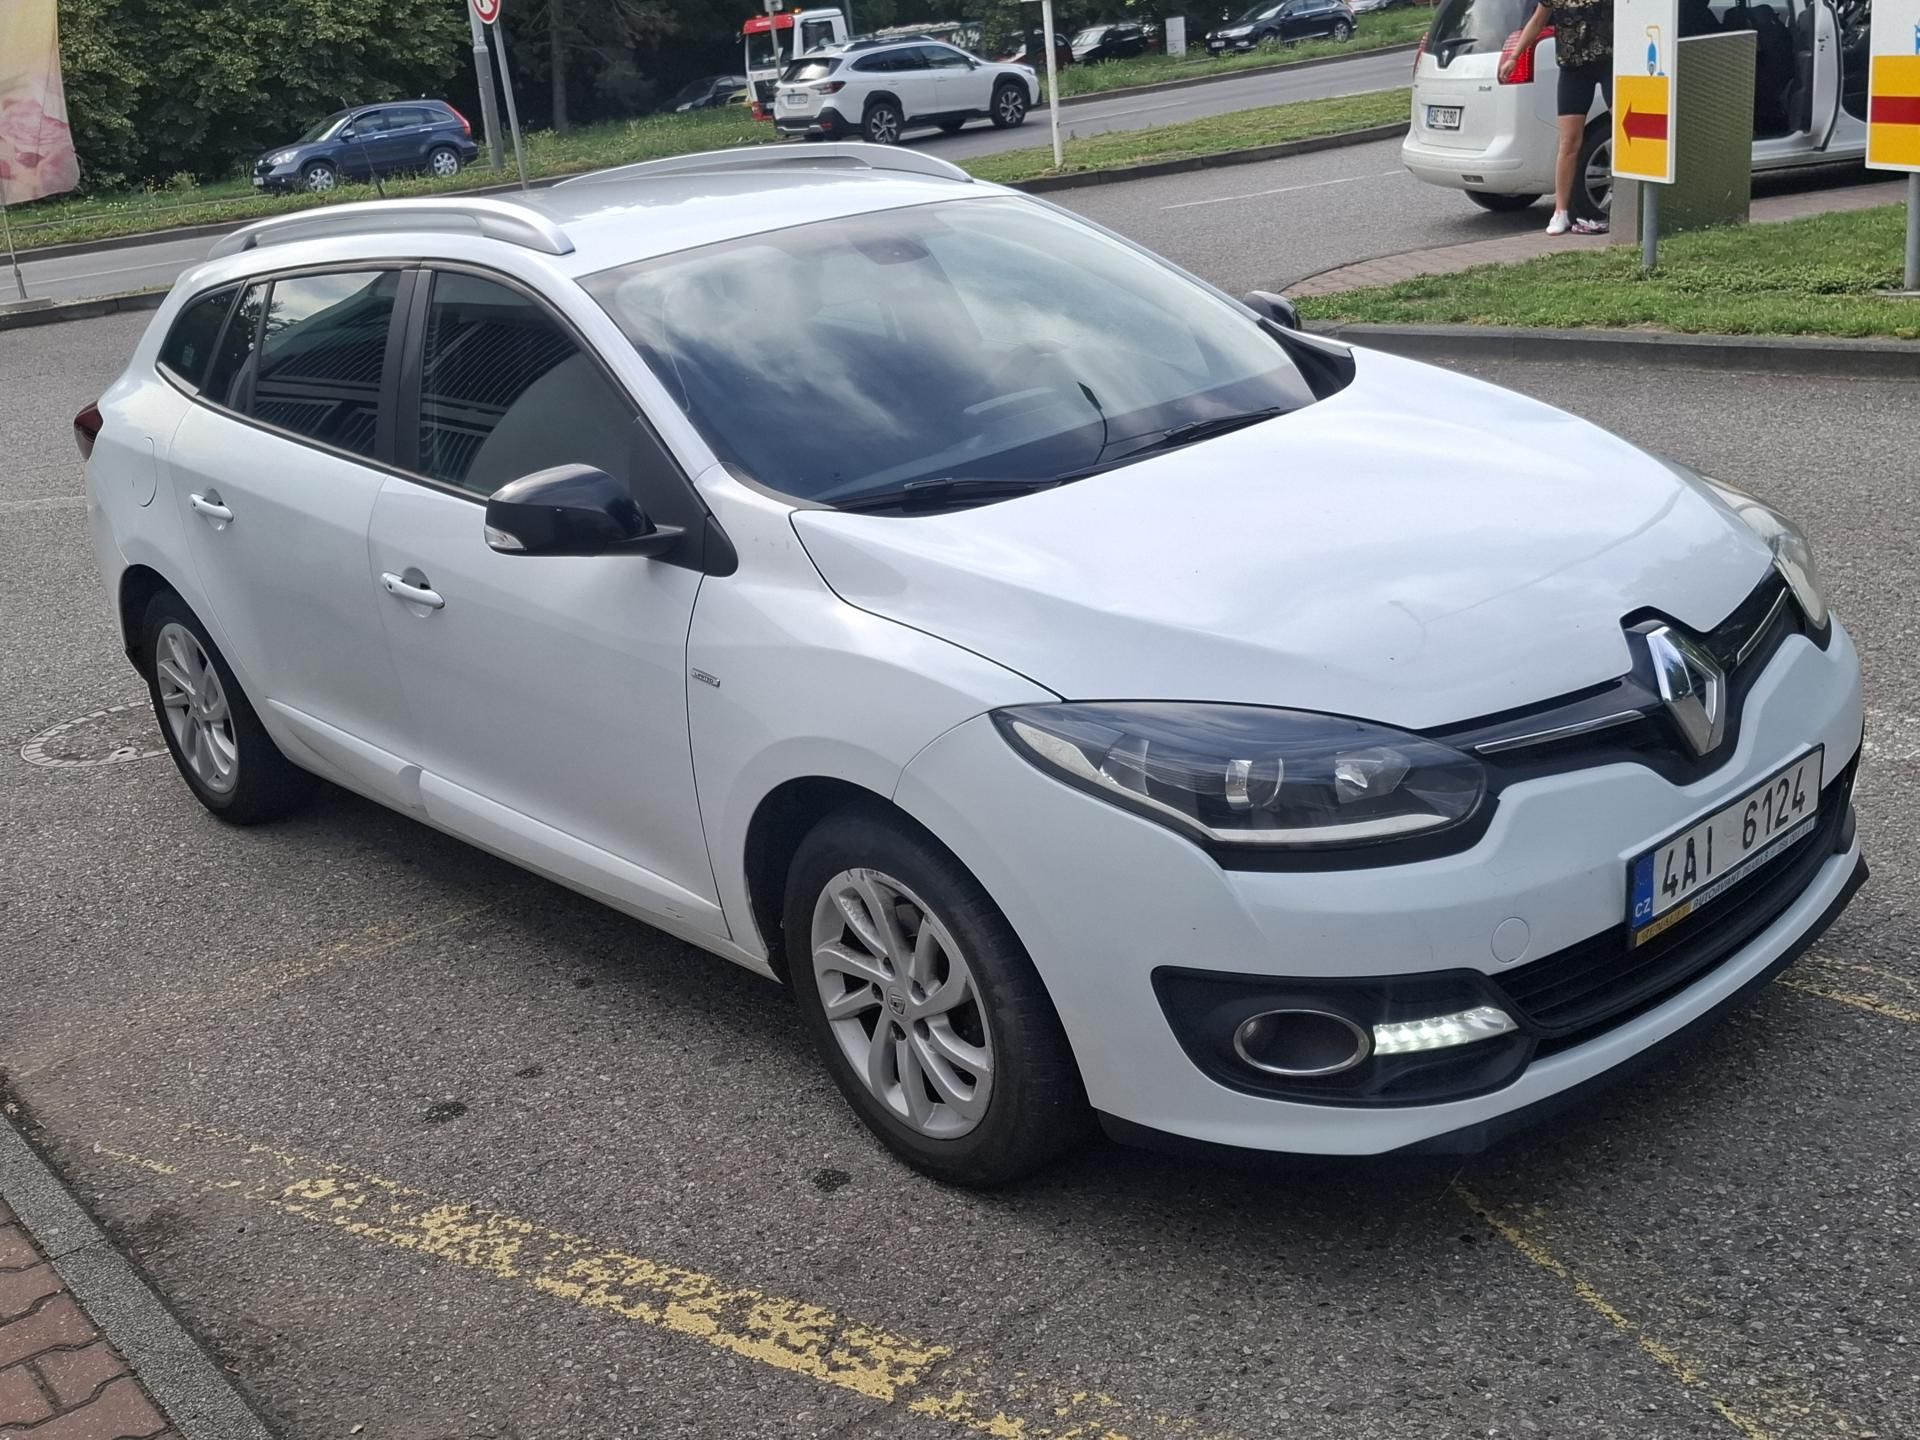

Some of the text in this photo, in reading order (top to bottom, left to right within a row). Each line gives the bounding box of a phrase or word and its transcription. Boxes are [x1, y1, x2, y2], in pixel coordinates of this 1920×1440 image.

[1661, 826, 1713, 898] 4AI
[1742, 766, 1806, 850] 6124
[1634, 897, 1651, 918] CZ
